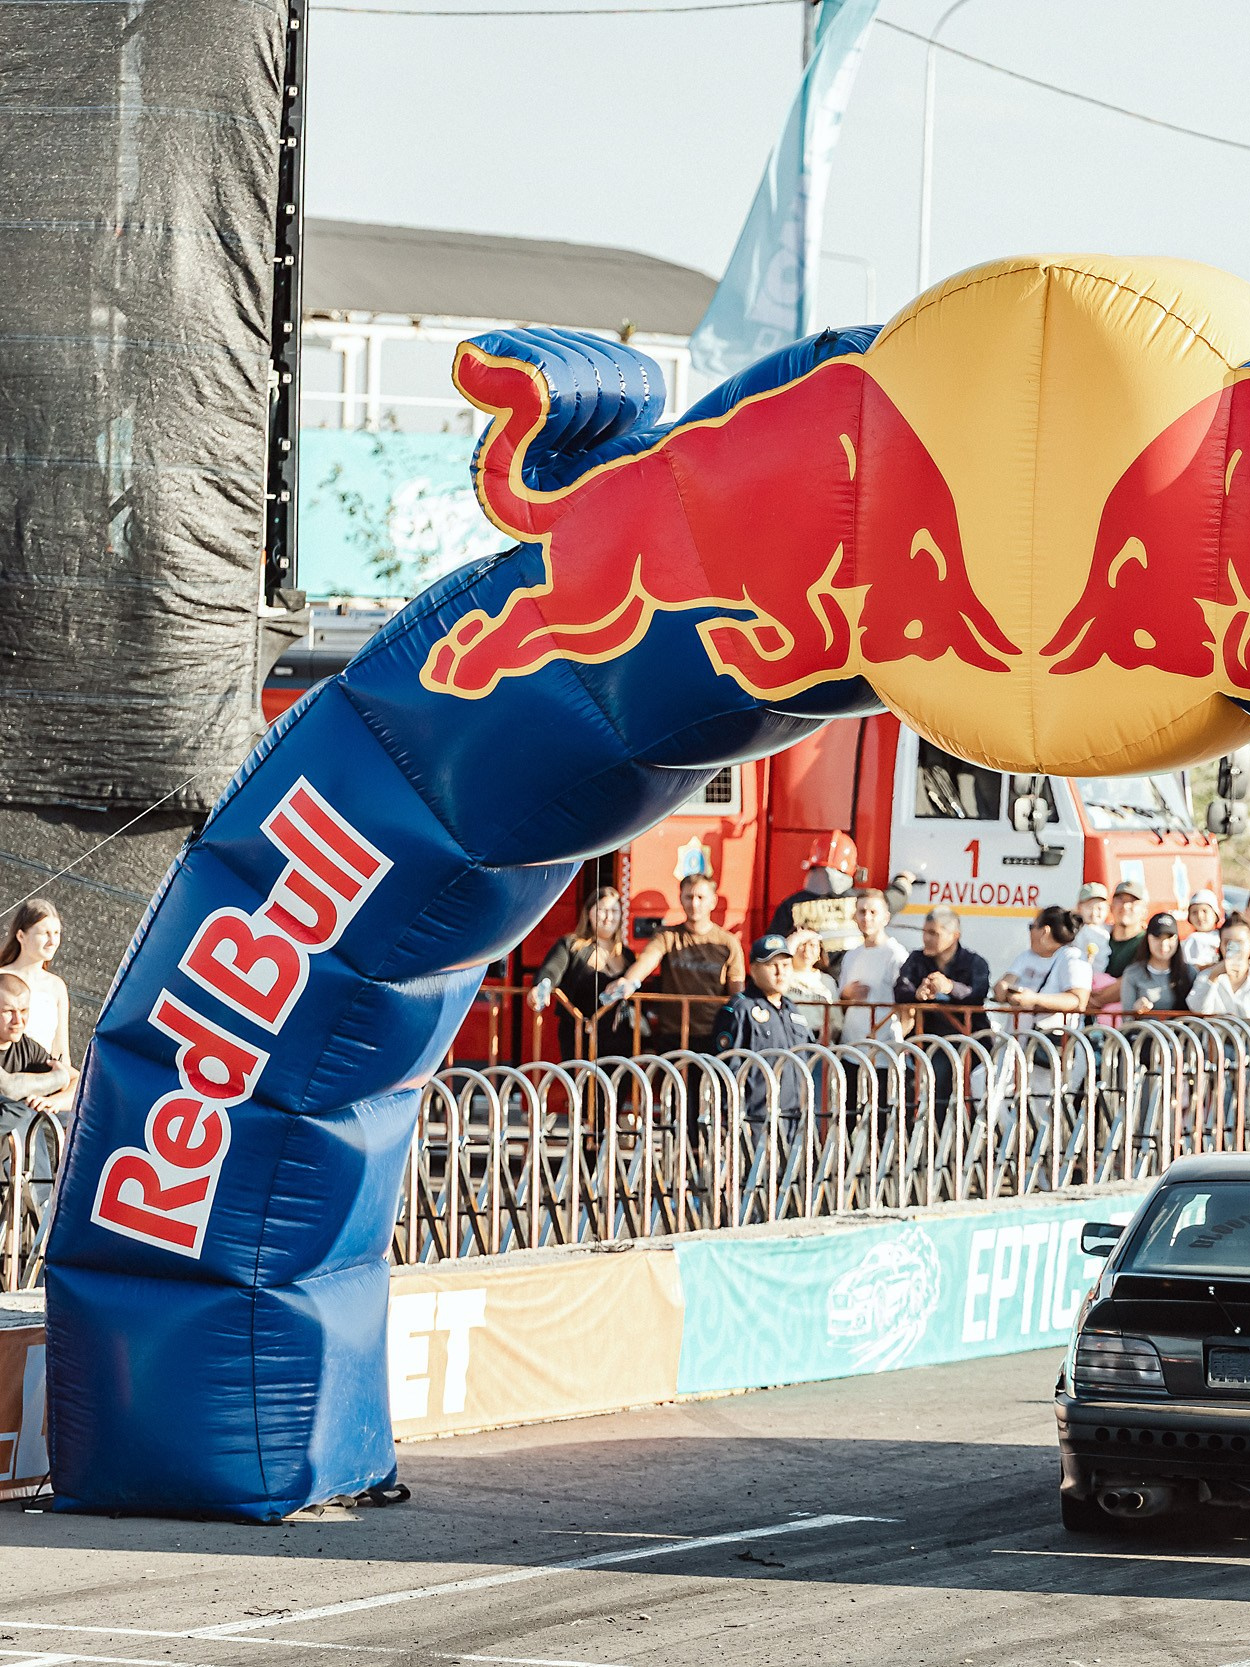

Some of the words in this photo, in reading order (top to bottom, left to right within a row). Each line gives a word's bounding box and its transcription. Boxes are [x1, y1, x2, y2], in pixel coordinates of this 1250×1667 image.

[180, 778, 391, 1033] Bull
[929, 882, 1039, 906] PAVLODAR
[964, 839, 980, 878] 1
[93, 990, 268, 1257] Red
